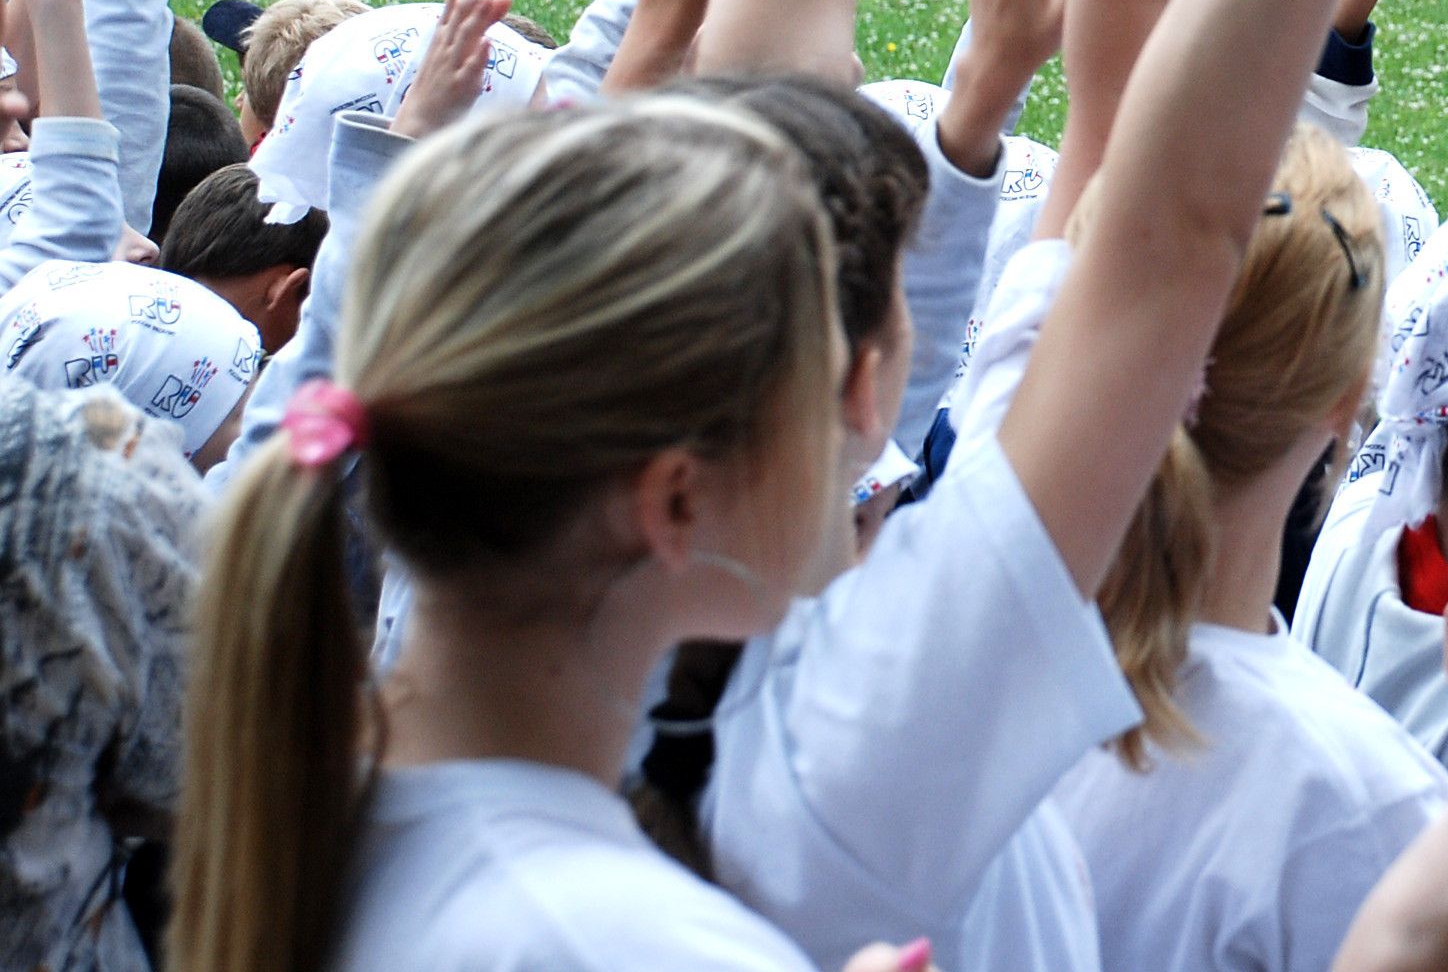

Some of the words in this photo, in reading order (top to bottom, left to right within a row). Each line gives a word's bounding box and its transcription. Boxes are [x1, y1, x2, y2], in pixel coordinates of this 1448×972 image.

[1001, 169, 1044, 194] RU
[128, 295, 181, 325] RU
[151, 374, 202, 418] RU
